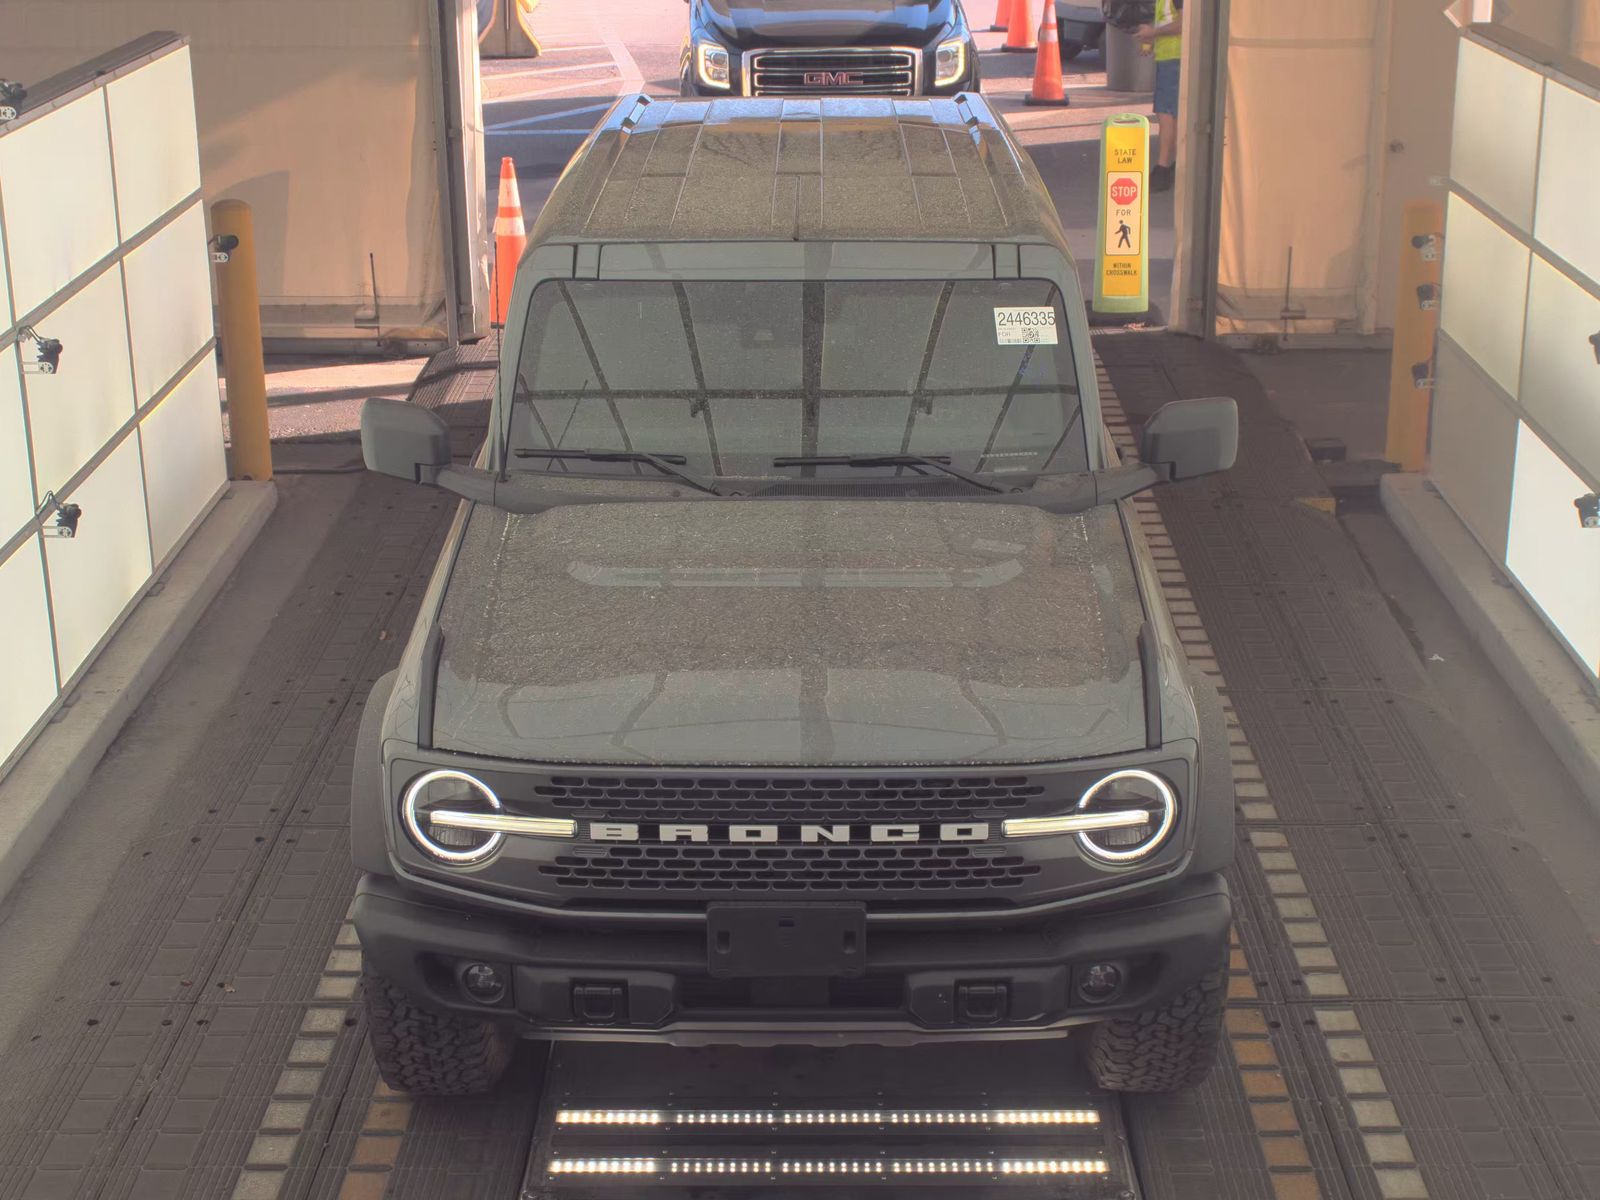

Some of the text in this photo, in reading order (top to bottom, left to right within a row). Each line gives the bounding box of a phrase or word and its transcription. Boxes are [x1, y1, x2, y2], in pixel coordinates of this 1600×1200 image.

[804, 72, 864, 85] GMC
[1111, 186, 1137, 197] STOP
[998, 312, 1056, 326] 2446335
[590, 823, 989, 842] BRONCO
